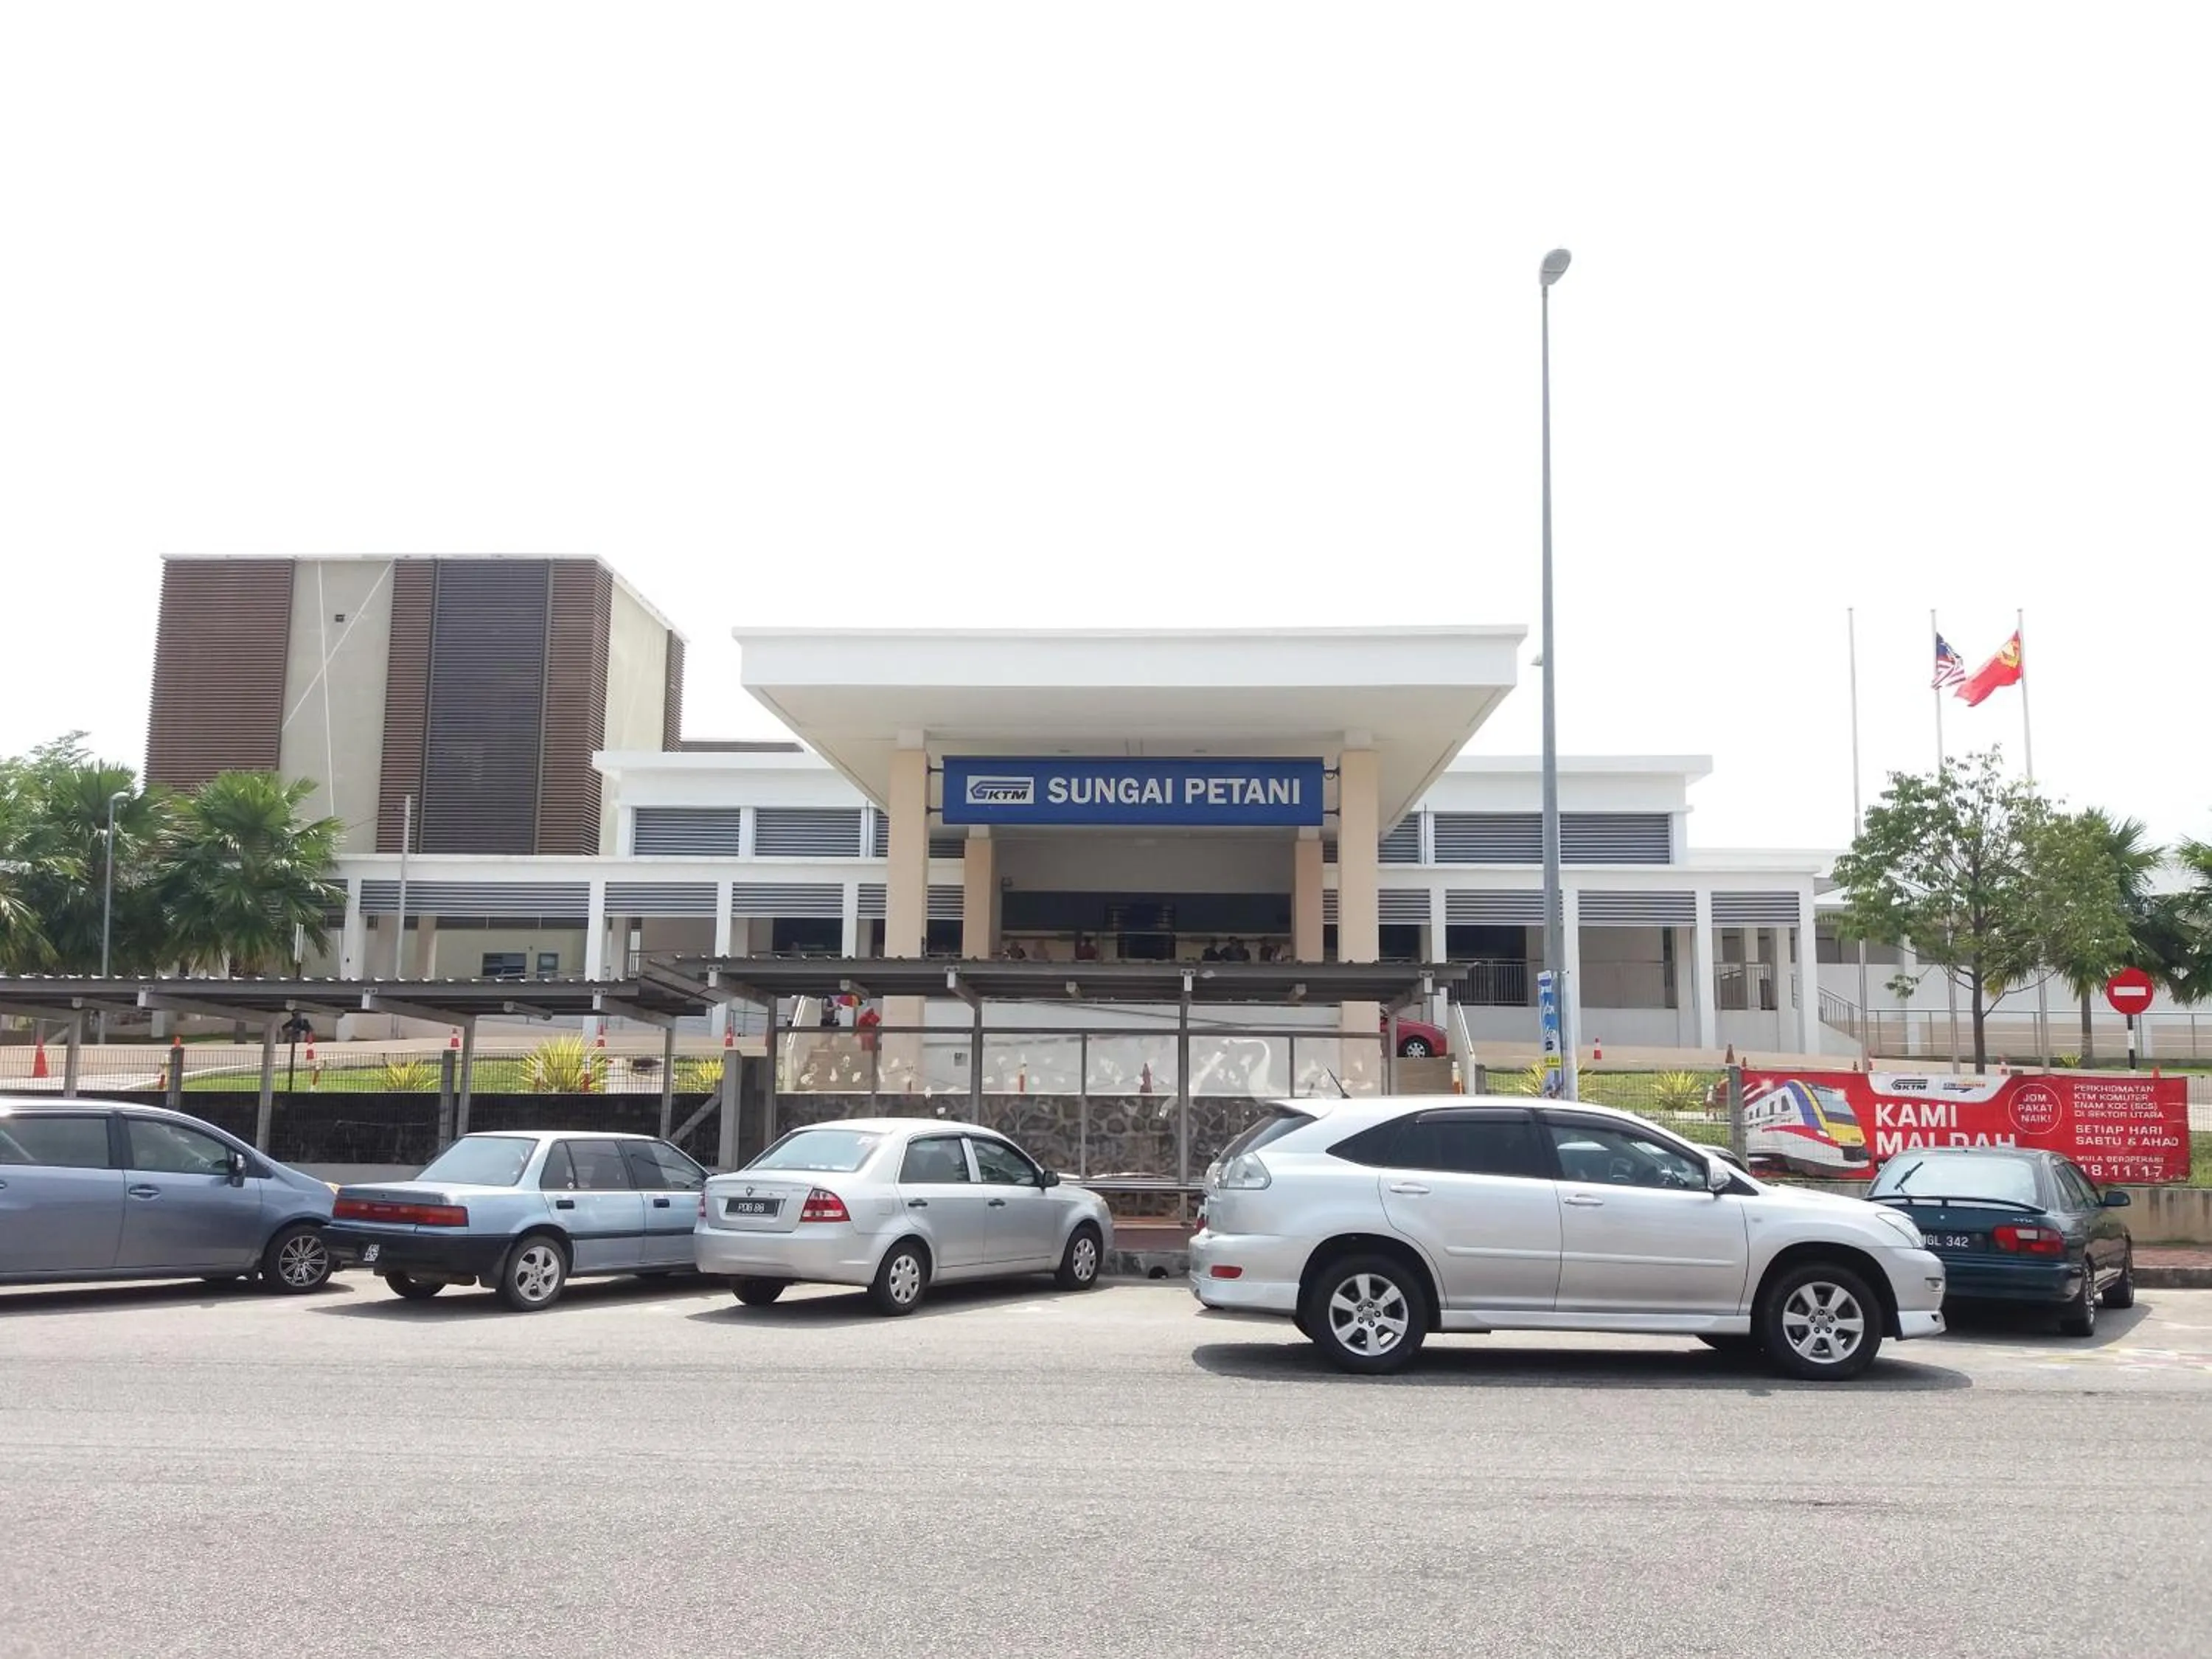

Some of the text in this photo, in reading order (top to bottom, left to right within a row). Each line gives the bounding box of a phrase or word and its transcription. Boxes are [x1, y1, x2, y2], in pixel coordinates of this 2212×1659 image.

[988, 790, 1028, 800] KTM
[1047, 776, 1299, 804] SUNGAI PETANI
[2073, 1084, 2154, 1093] PERKHIDMATAN
[2023, 1093, 2047, 1102] JOM
[2073, 1093, 2149, 1102] KTM KOMUTER
[2017, 1104, 2053, 1113] PAKAT
[1875, 1103, 1957, 1127] KAMI
[2021, 1114, 2052, 1123] NAIK!
[2076, 1124, 2163, 1135] SETIAP HARI
[2076, 1136, 2179, 1147] SABTU & AHAD
[2080, 1164, 2163, 1178] 18.11.17
[1946, 1235, 1969, 1248] 342
